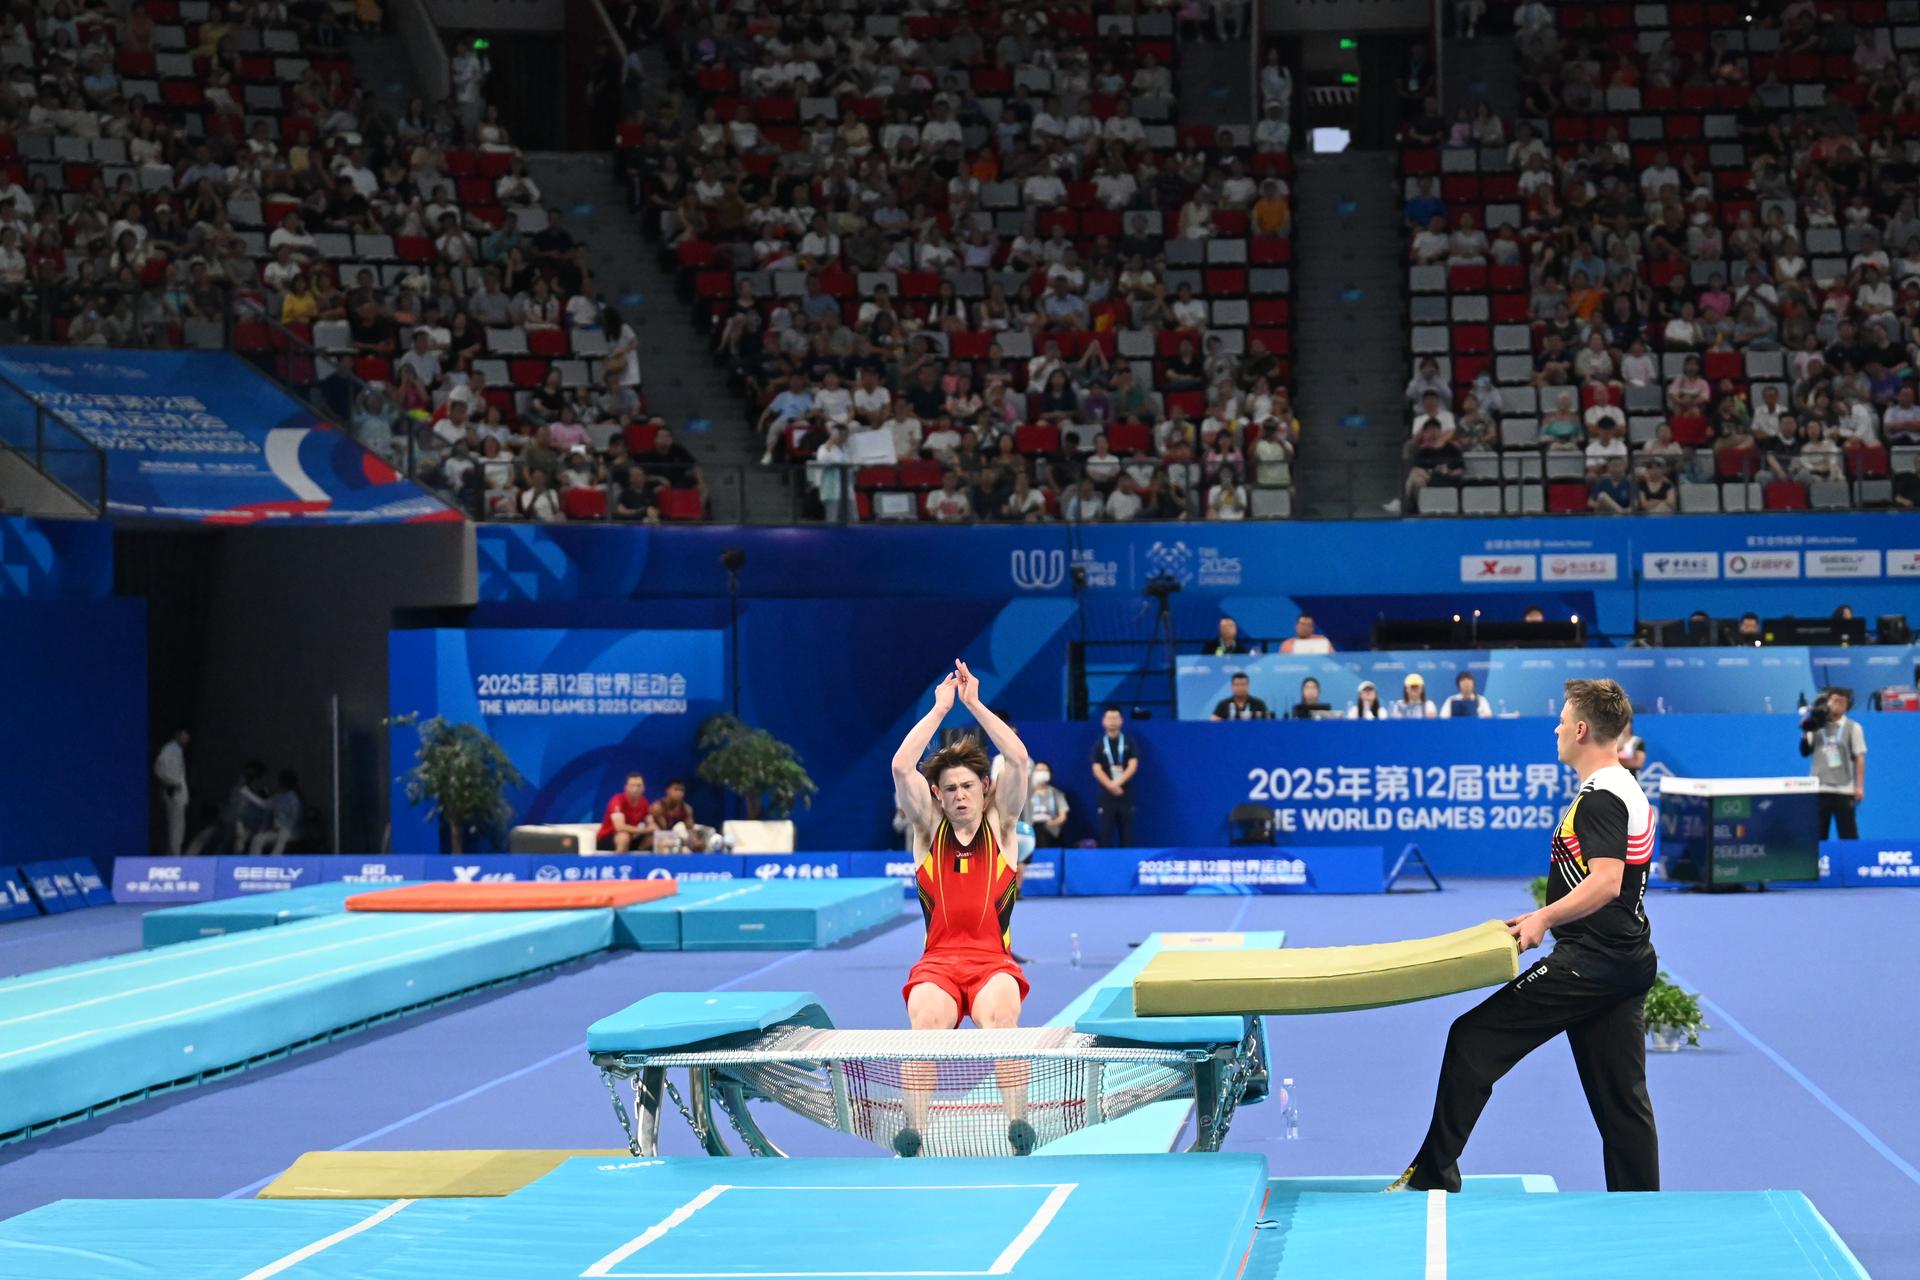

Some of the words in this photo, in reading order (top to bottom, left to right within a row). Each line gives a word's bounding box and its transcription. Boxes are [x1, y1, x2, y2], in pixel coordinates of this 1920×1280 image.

[477, 673, 688, 696] 2025年第12届世界运动会
[479, 700, 502, 714] THE
[505, 700, 550, 714] WORLD
[552, 700, 595, 714] GAMES
[598, 700, 629, 714] 2025
[630, 700, 688, 714] CHENGDU
[1302, 808, 1393, 831] WORLD
[1397, 806, 1485, 830] GAMES
[1490, 806, 1554, 829] 2025
[233, 867, 303, 880] GEELY
[1516, 965, 1549, 989] BEL
